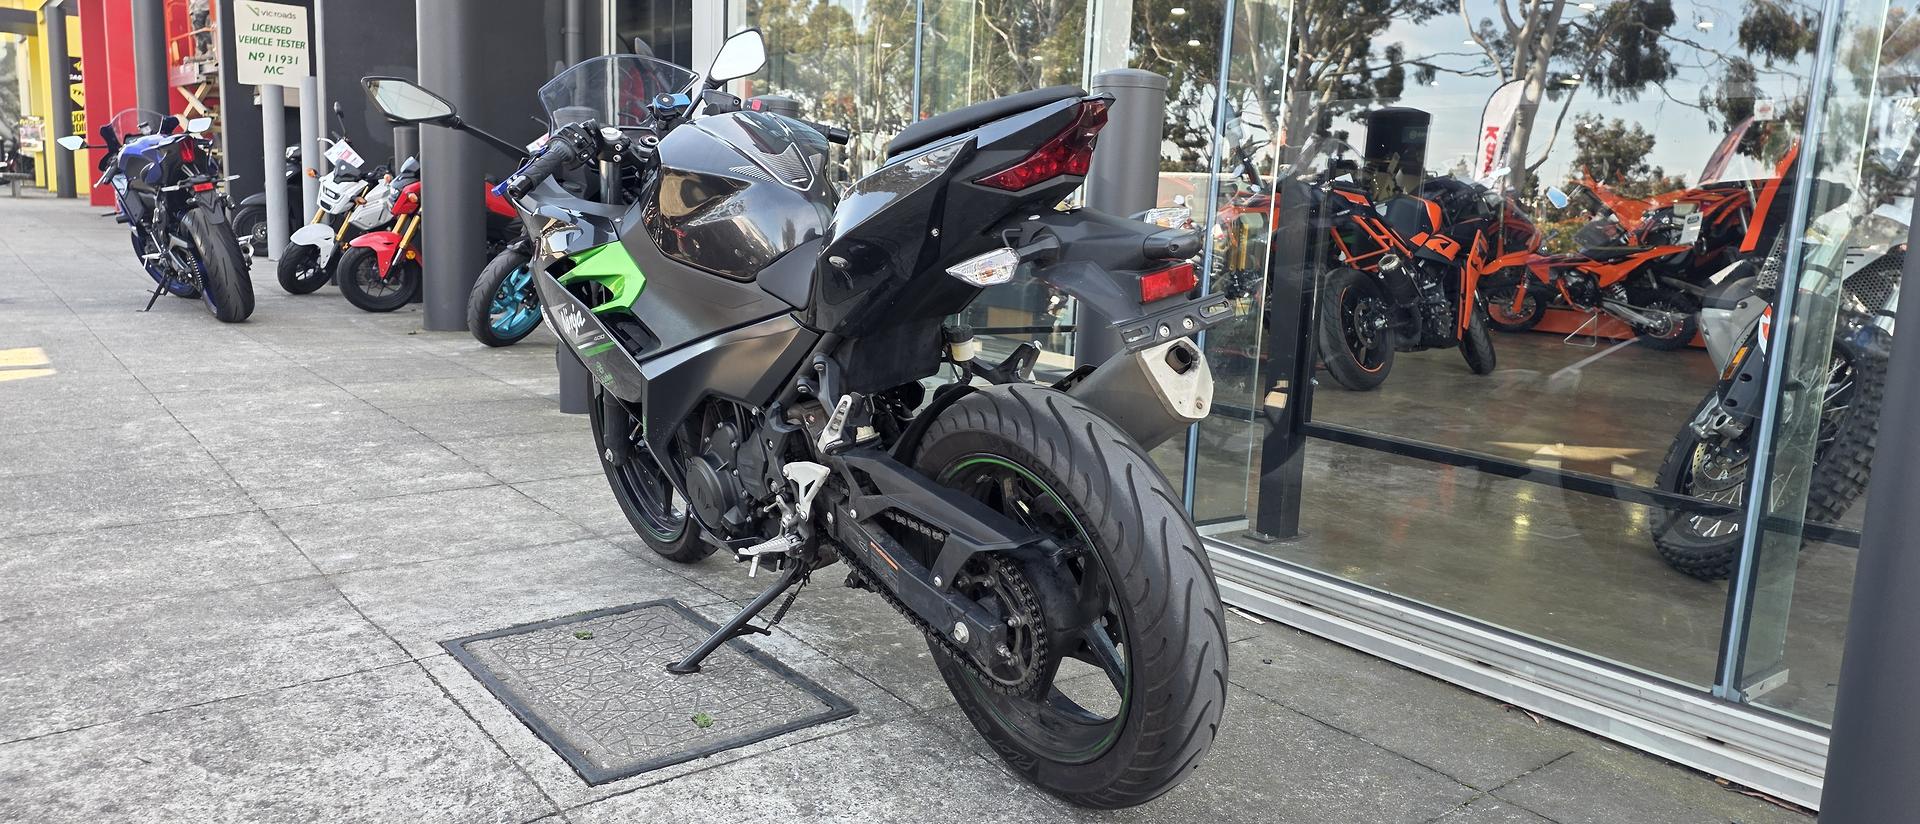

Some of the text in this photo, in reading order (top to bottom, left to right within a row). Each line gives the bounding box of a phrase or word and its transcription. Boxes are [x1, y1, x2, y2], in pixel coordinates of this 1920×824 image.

[252, 23, 292, 35] LICENSED
[239, 35, 306, 50] VEHICLE TESTER
[268, 54, 299, 65] 11931
[263, 65, 285, 75] MC
[560, 303, 586, 338] Ninja
